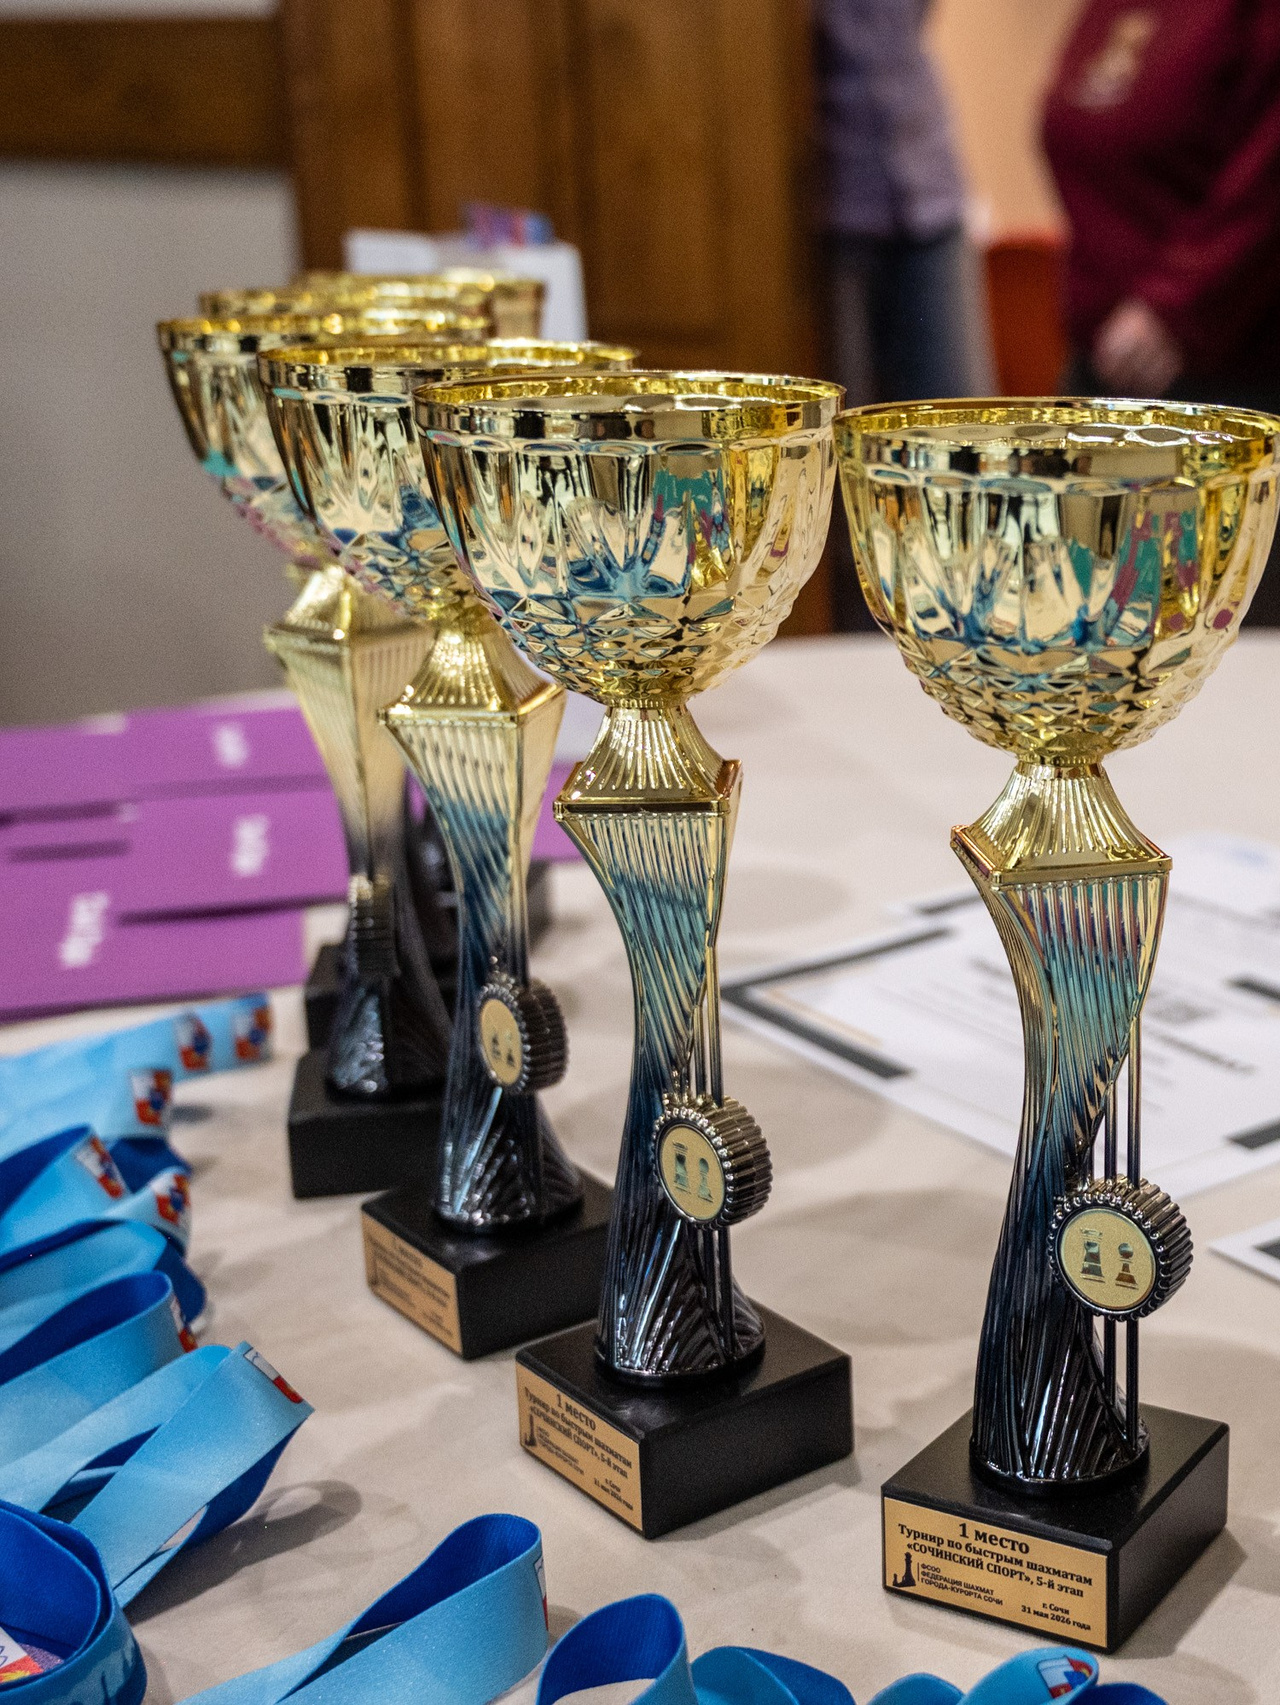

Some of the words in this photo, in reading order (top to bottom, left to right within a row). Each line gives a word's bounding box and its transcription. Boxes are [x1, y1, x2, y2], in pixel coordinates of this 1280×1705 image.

[564, 1401, 596, 1431] место
[959, 1522, 969, 1539] 1
[974, 1529, 1030, 1554] место
[898, 1523, 945, 1547] Турнир
[947, 1539, 962, 1550] по
[965, 1543, 1023, 1568] быстрым
[1026, 1561, 1093, 1586] шахматам
[907, 1542, 984, 1570] «СОЧИНСКИЙ
[986, 1562, 1034, 1585] СПОРТ»,
[1036, 1576, 1055, 1589] 5-й
[1057, 1583, 1084, 1597] этап
[963, 1582, 994, 1595] ШАХМАТ
[1021, 1605, 1031, 1614] 31
[1050, 1612, 1071, 1625] 2026
[1072, 1620, 1091, 1631] года
[1049, 1603, 1070, 1615] Сочи
